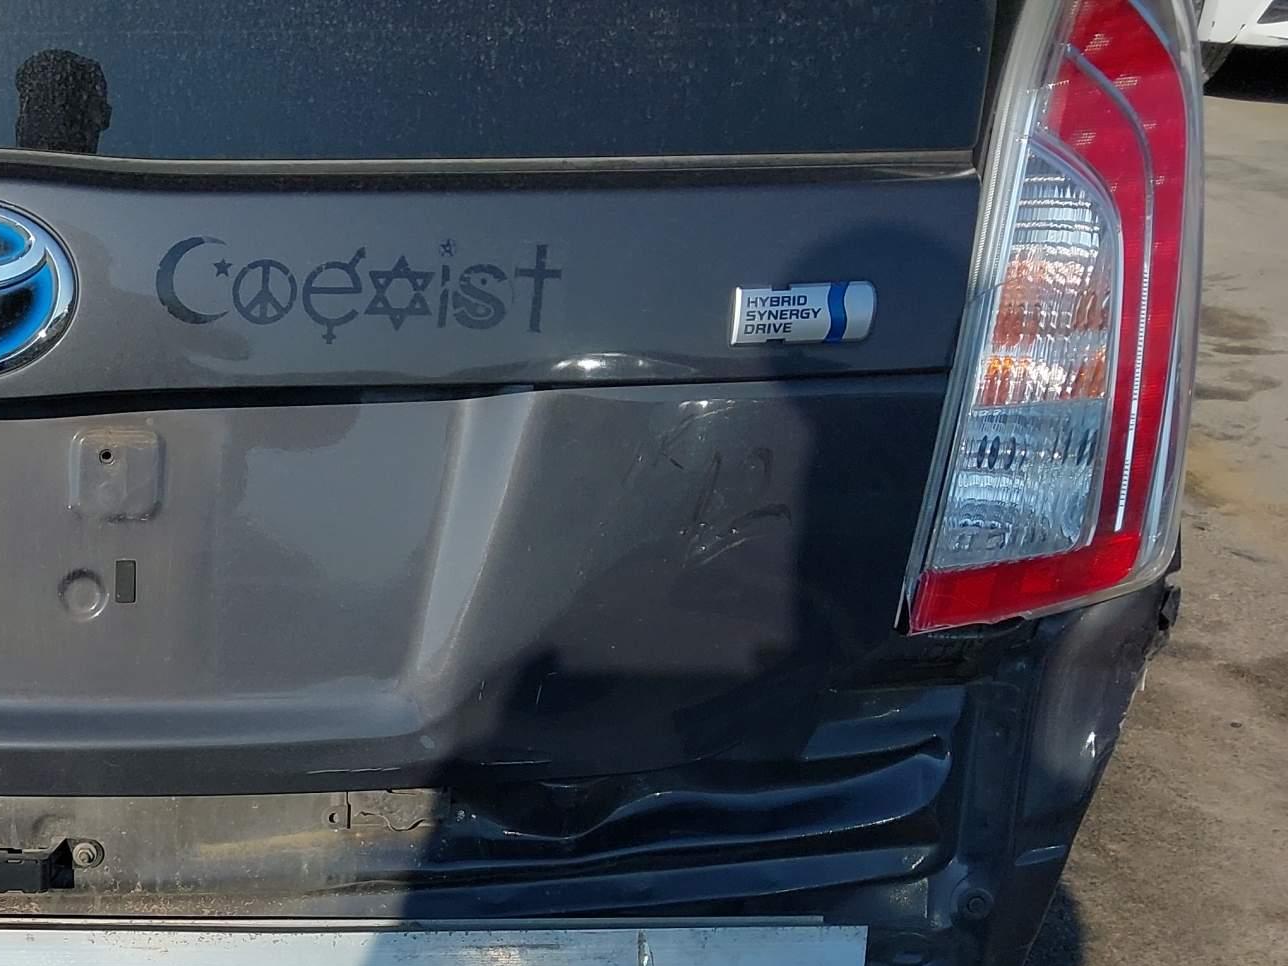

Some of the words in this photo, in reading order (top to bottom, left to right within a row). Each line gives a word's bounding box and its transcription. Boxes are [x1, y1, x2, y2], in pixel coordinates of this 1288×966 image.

[747, 295, 807, 308] HYBRID
[746, 308, 822, 321] SYNERGY
[744, 322, 792, 335] DRIVE
